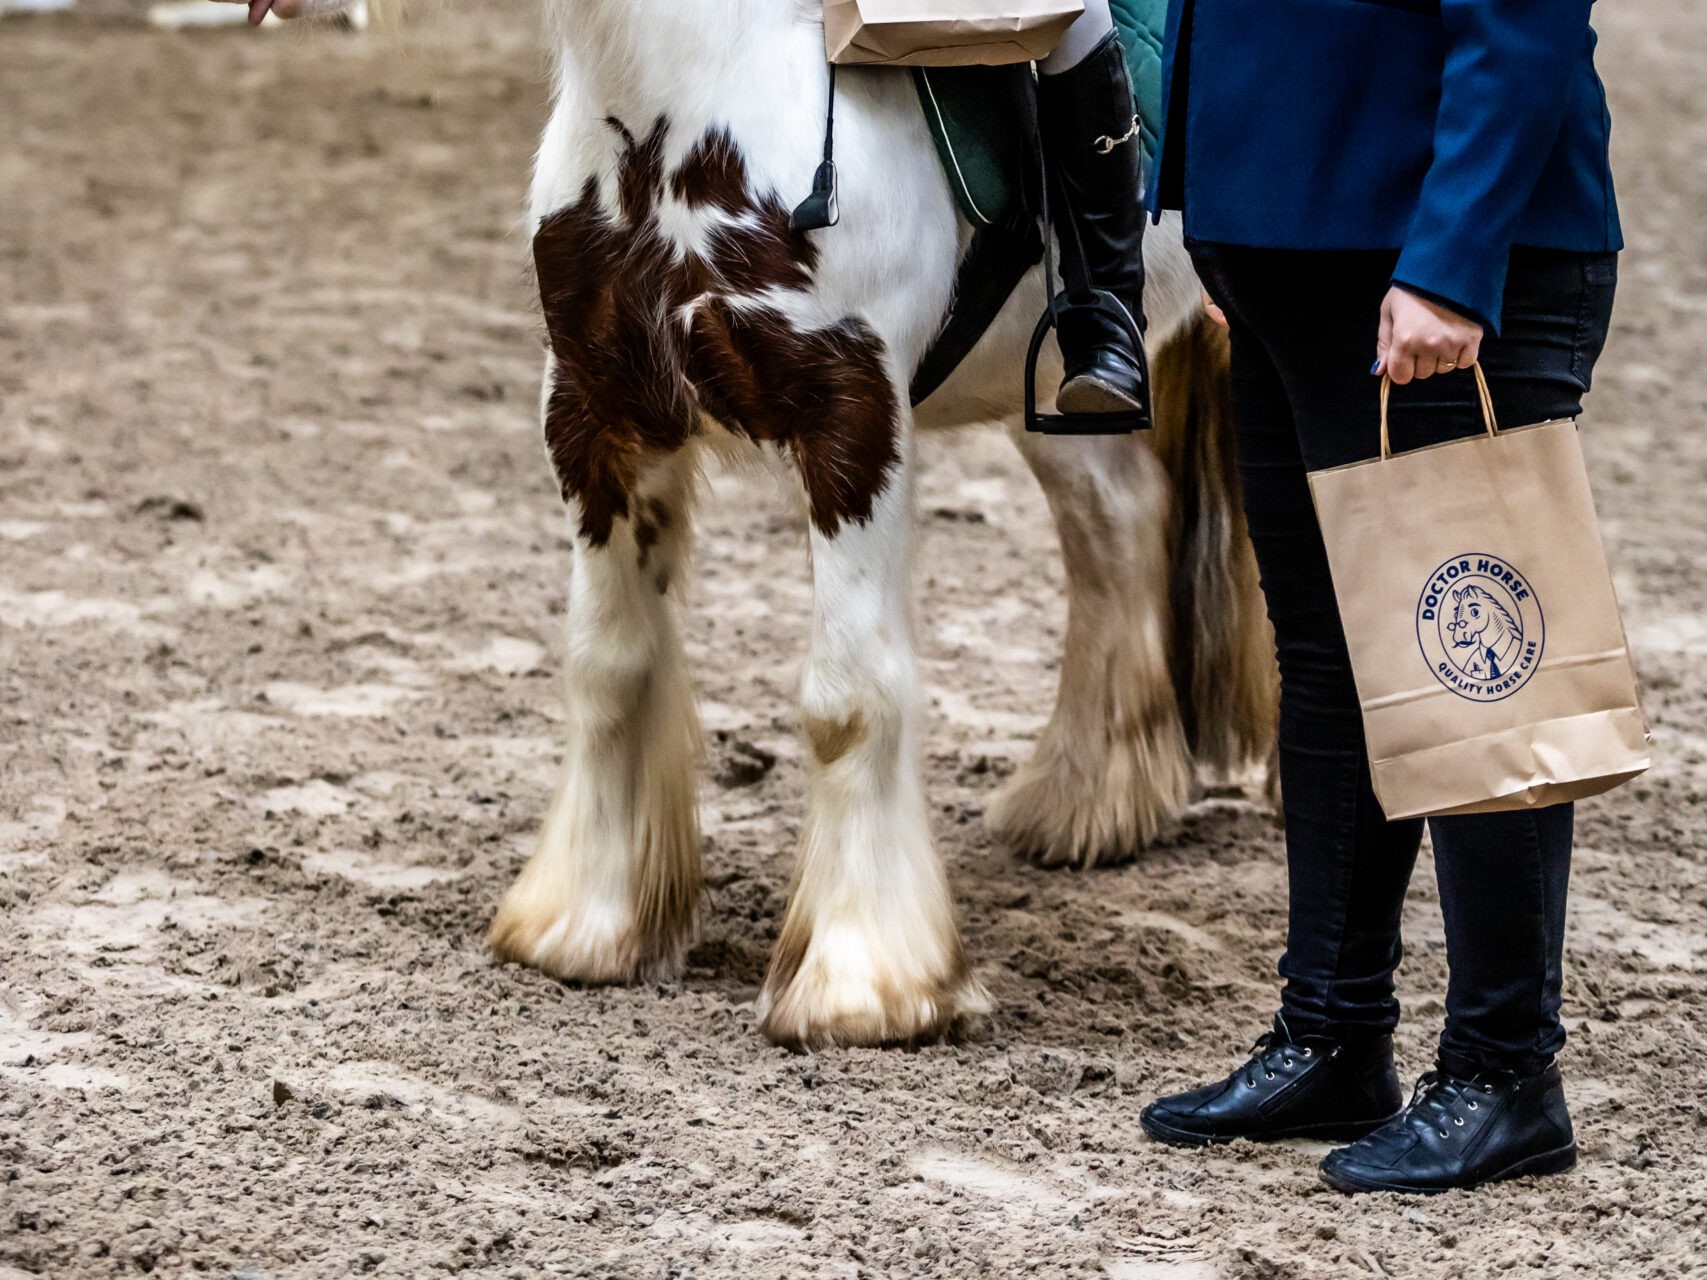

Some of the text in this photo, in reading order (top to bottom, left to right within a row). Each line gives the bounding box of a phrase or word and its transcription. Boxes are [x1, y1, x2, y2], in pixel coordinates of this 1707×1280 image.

[1422, 559, 1529, 620] DOCTOR HORSE
[1438, 641, 1537, 695] QUALITY HORSE CARE
